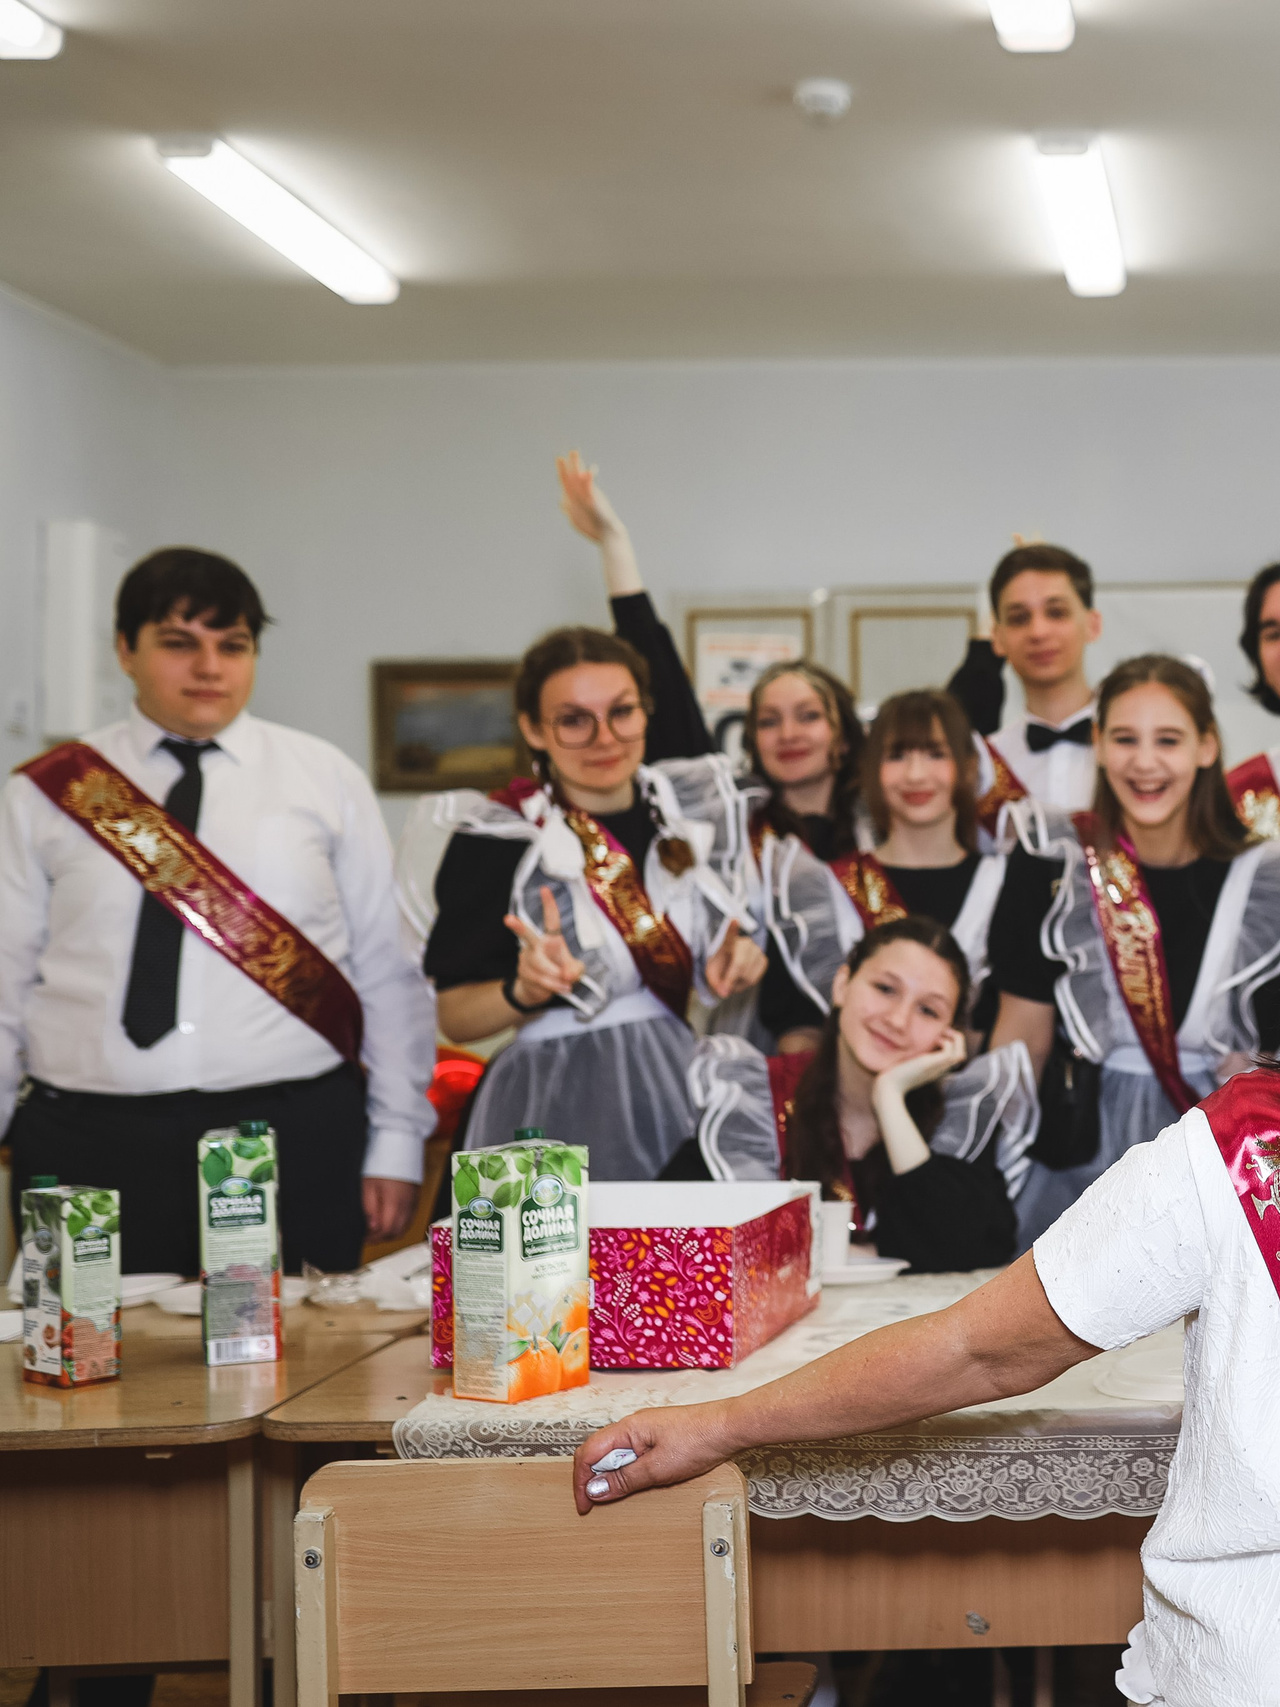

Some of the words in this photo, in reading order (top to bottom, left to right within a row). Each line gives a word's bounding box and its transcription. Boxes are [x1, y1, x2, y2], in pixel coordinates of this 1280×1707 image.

[460, 1217, 501, 1231] СОЧНАЯ
[522, 1204, 575, 1227] СОЧНАЯ
[460, 1229, 501, 1241] ДОЛИНА
[523, 1220, 576, 1243] ДОЛИНА
